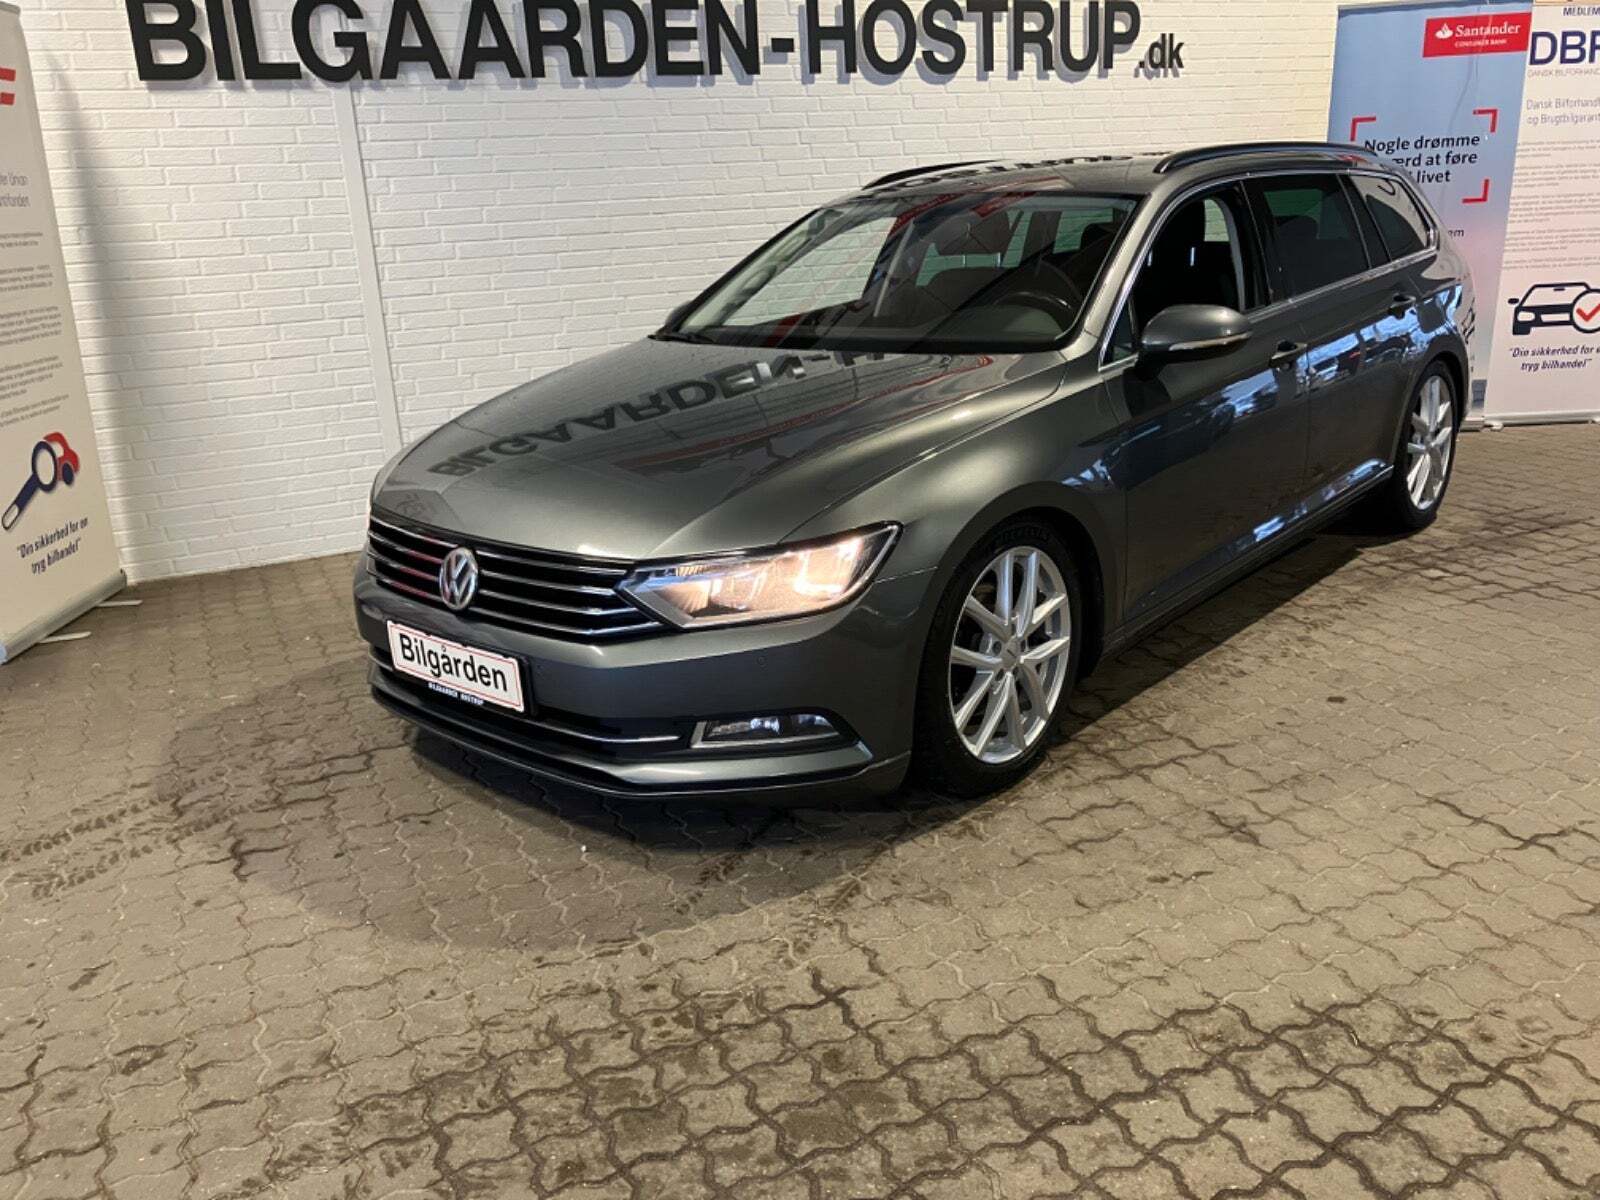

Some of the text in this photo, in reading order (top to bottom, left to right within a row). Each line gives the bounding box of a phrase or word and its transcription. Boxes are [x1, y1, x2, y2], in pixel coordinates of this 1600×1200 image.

[1455, 21, 1521, 37] Santander
[1364, 135, 1480, 154] Nogle drømme
[1425, 153, 1441, 166] at
[1445, 151, 1478, 165] føre
[1417, 170, 1451, 183] livet
[1521, 362, 1540, 372] tryg
[399, 633, 508, 692] Bilgården
